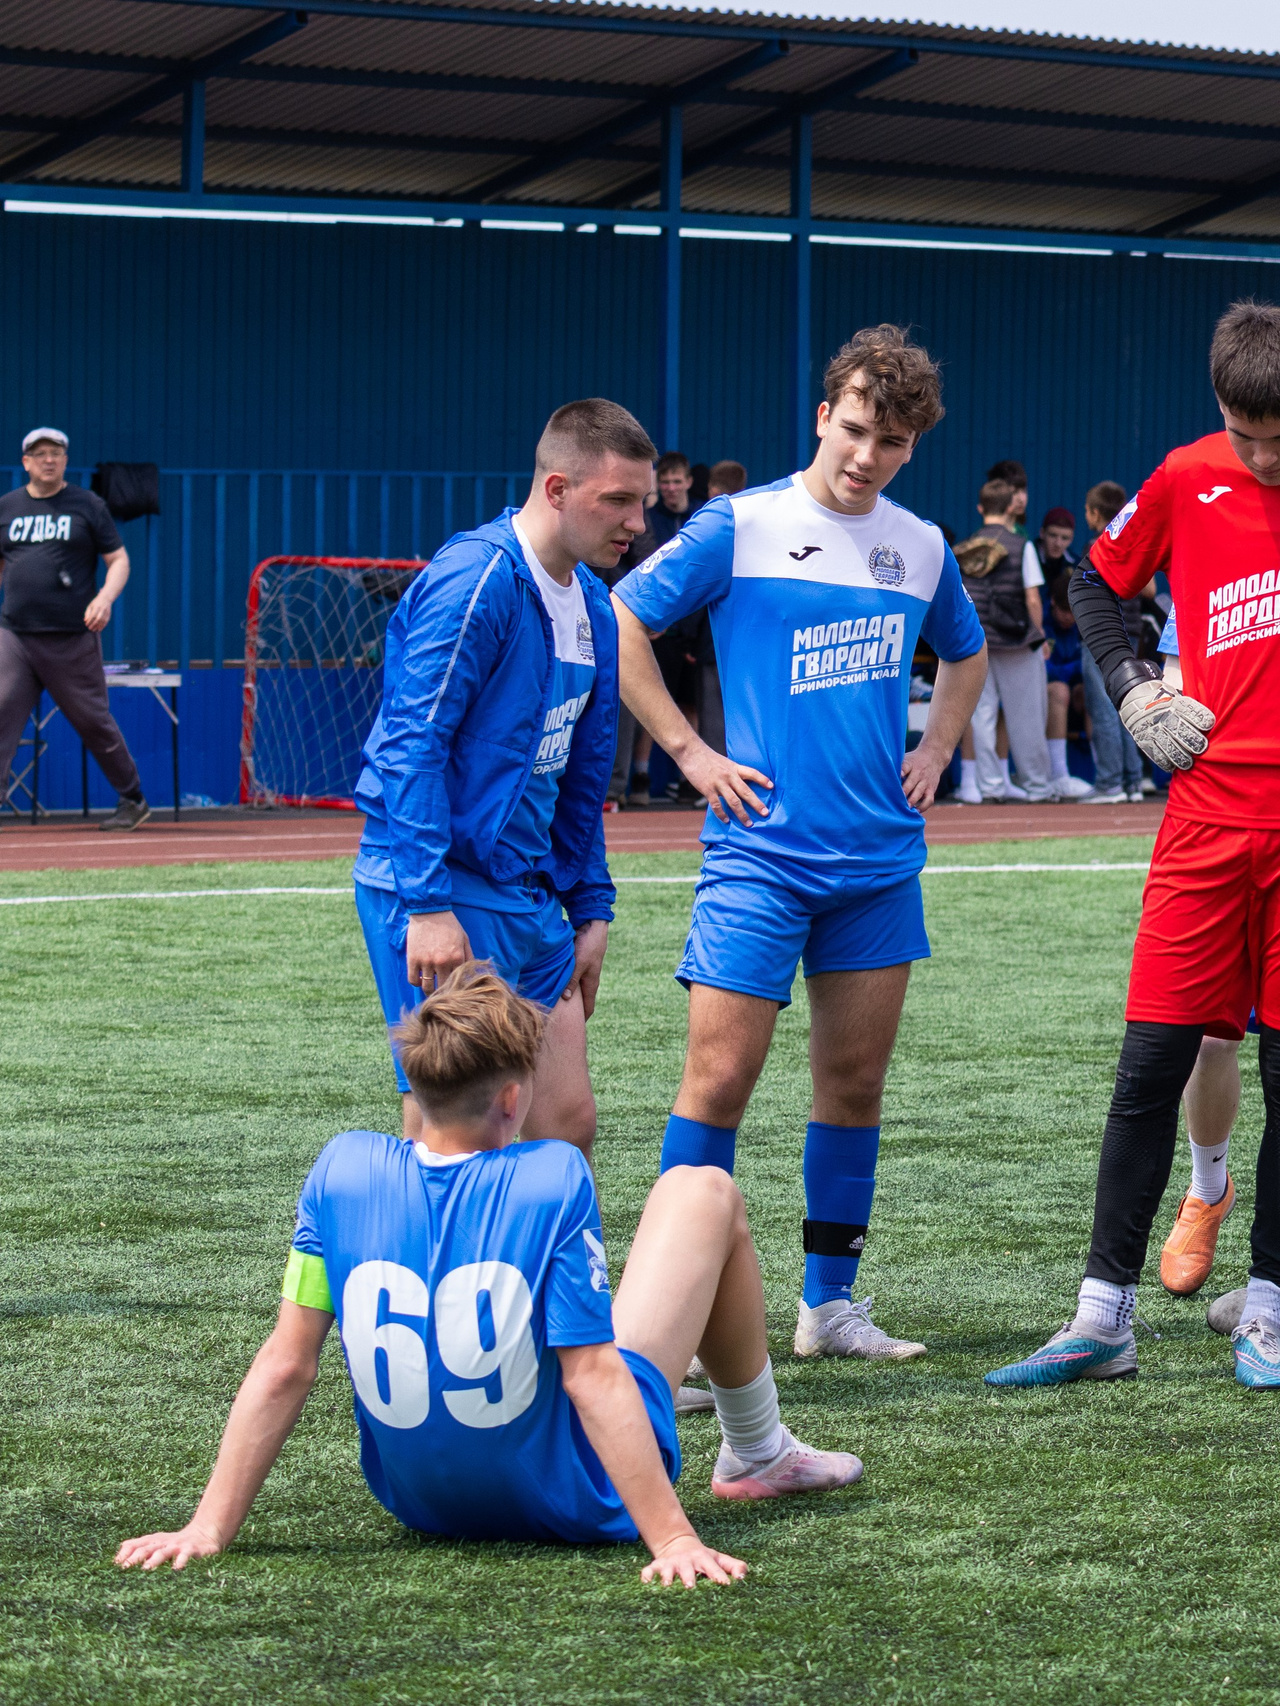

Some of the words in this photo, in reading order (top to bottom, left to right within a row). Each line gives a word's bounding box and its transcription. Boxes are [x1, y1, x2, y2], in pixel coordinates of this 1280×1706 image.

[9, 514, 71, 542] СУДЬЯ
[790, 670, 869, 696] ПРИМОРСКИЙ
[342, 1260, 539, 1429] 69
